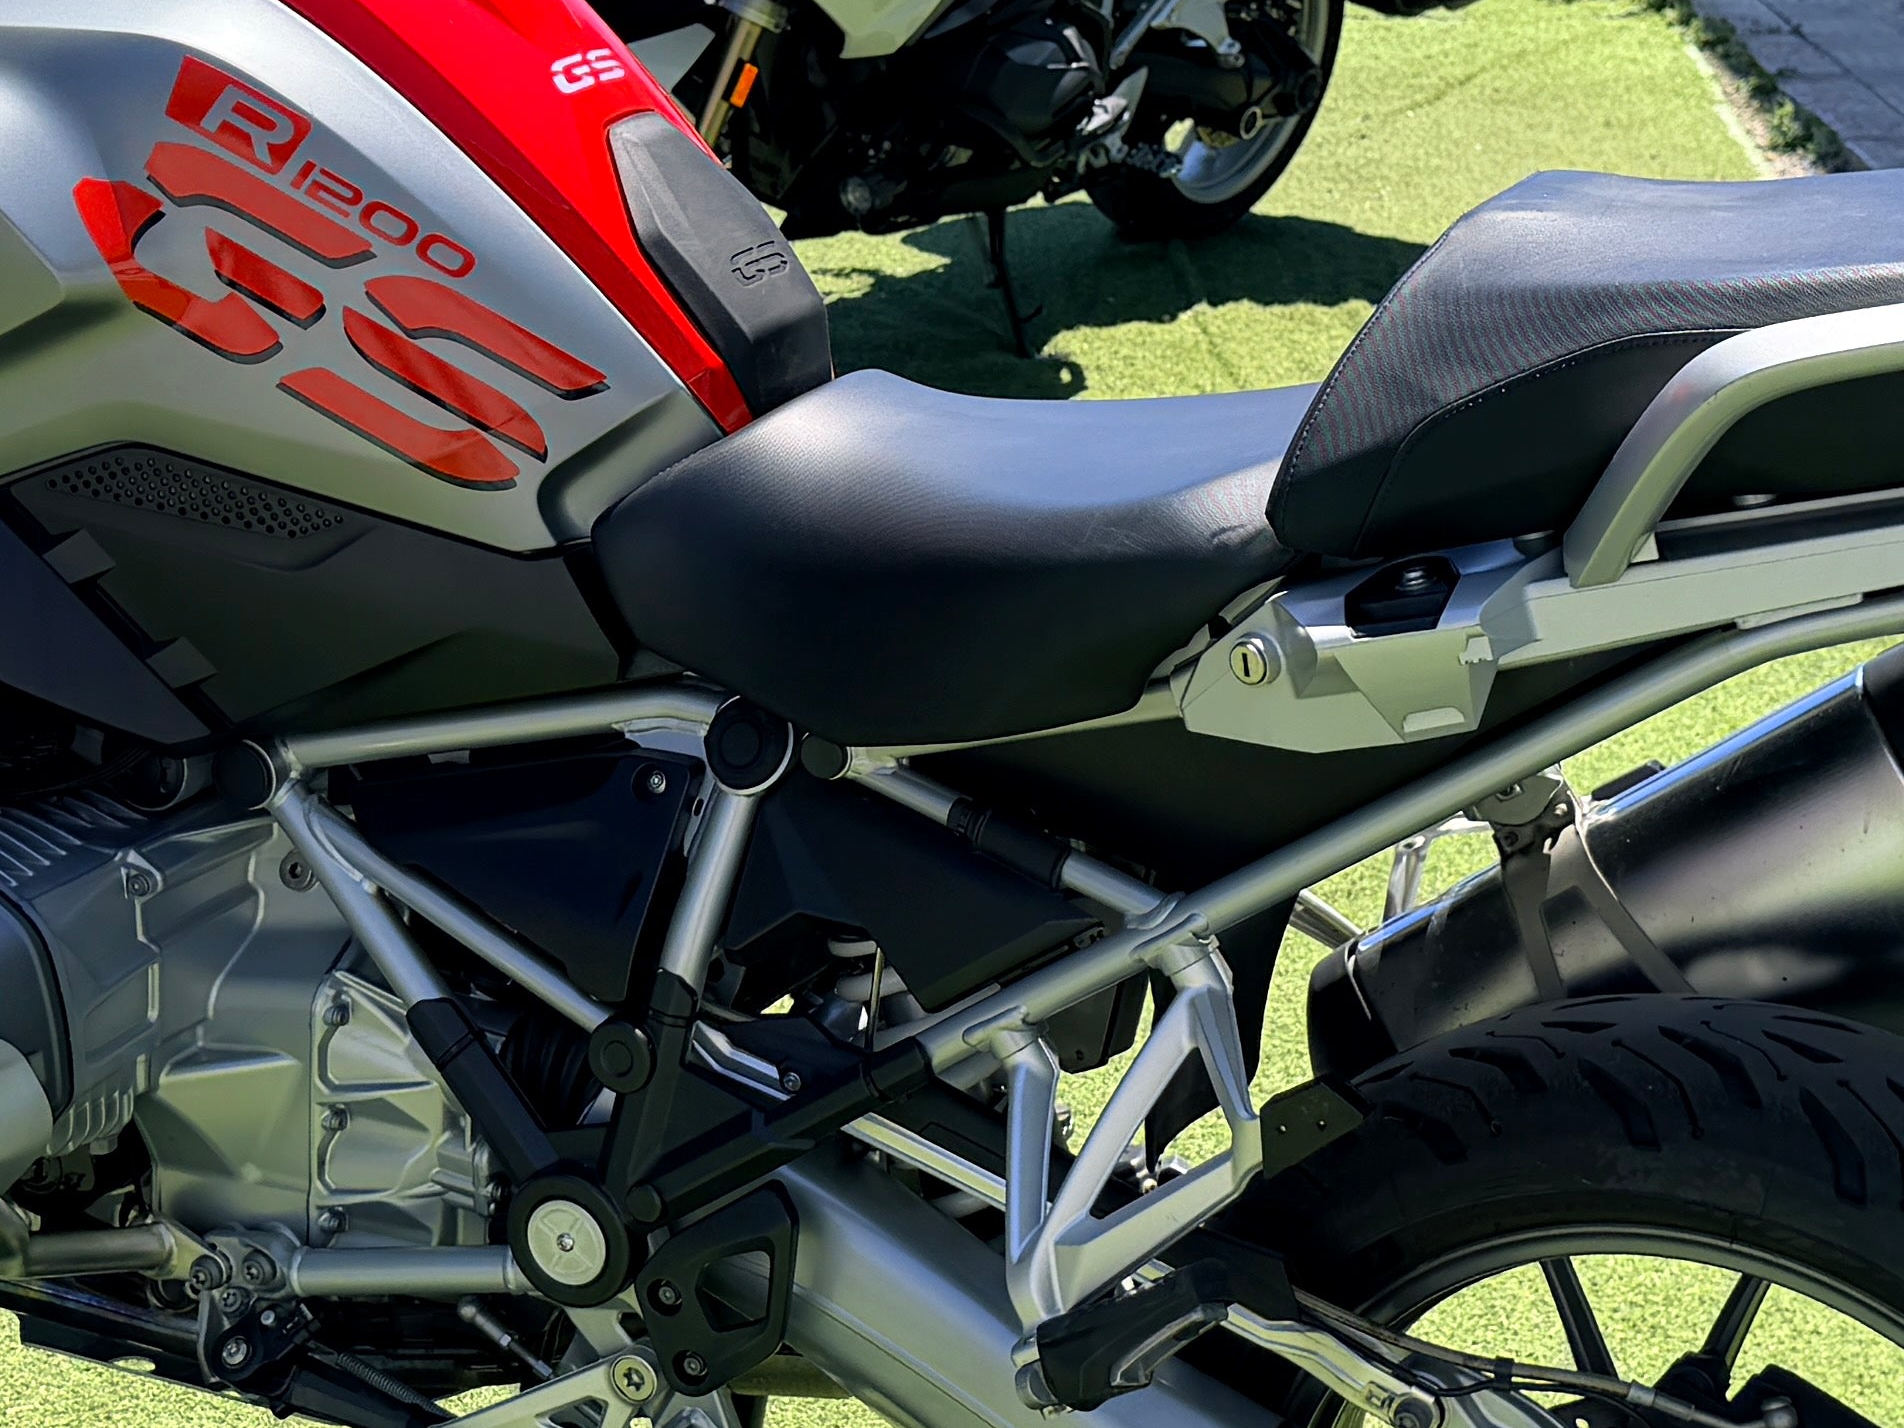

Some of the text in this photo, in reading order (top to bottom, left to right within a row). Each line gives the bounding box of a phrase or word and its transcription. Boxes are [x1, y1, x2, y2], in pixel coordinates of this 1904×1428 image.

[550, 48, 626, 94] GS
[200, 83, 478, 280] R 1200
[72, 140, 610, 492] GS
[730, 239, 788, 289] GS
